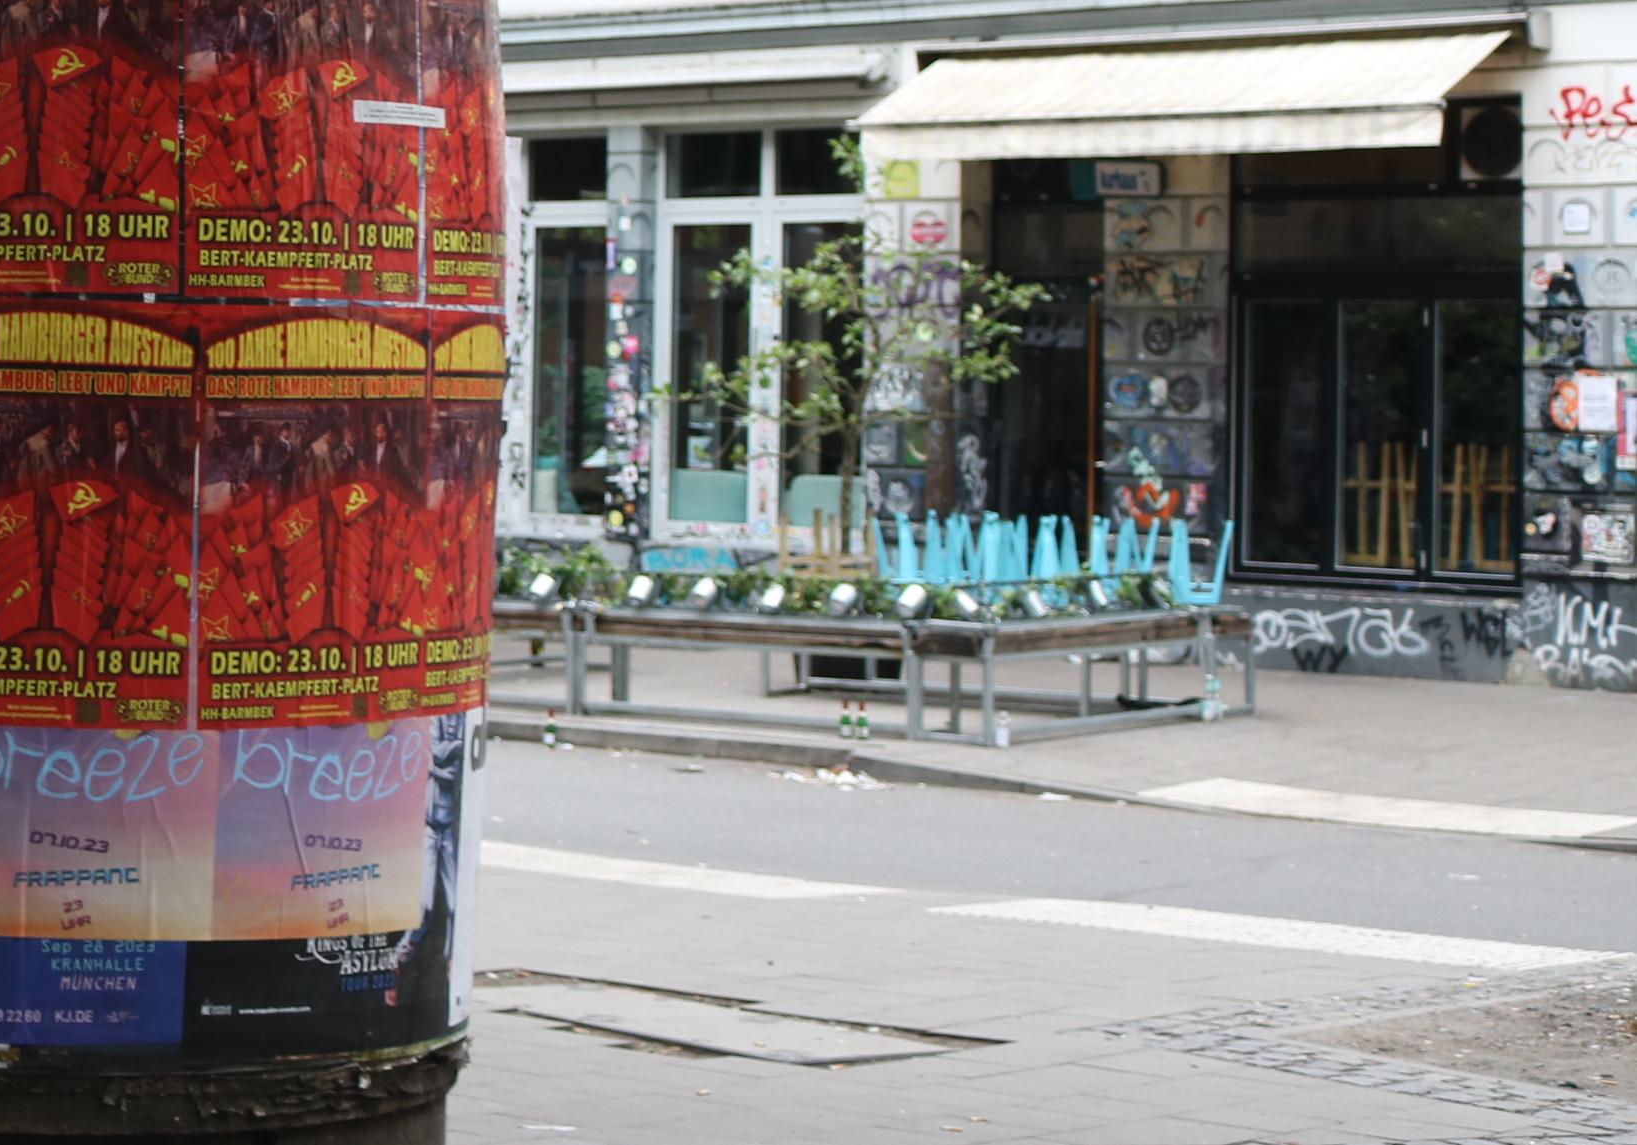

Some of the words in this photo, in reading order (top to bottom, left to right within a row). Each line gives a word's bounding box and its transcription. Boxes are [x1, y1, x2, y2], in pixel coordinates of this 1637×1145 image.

[84, 213, 111, 237] 18
[118, 215, 169, 239] UHR
[198, 218, 273, 243] DEMO:
[277, 221, 337, 245] 23.10.
[358, 223, 377, 247] 18
[381, 225, 415, 250] UHR
[118, 262, 160, 274] ROTER
[199, 250, 374, 271] BERT-KAEMPFERT-PLATZ
[109, 318, 194, 369] AUFSTAND
[57, 370, 94, 394] LEBT
[94, 371, 128, 395] UND
[129, 371, 193, 397] KÄMPFT!
[96, 650, 123, 674] 18
[129, 651, 181, 675] UHR
[210, 651, 282, 675] DEMO:
[287, 647, 347, 673] 23.10.
[365, 644, 383, 668] 18
[386, 642, 419, 667] UHR
[211, 676, 380, 700] BERT-KAEMPFERT-PLATZ
[129, 699, 170, 712] ROTER
[200, 705, 275, 721] HH-BARMBEK
[234, 729, 422, 802] breeze
[29, 830, 110, 854] 07.10.23
[304, 834, 363, 852] 07.10.23
[62, 900, 84, 914] 23
[61, 914, 92, 932] UHR
[41, 939, 72, 954] Sep
[114, 940, 156, 953] 2023
[51, 957, 145, 971] KRANHALLE
[60, 975, 137, 991] MÜNCHEN
